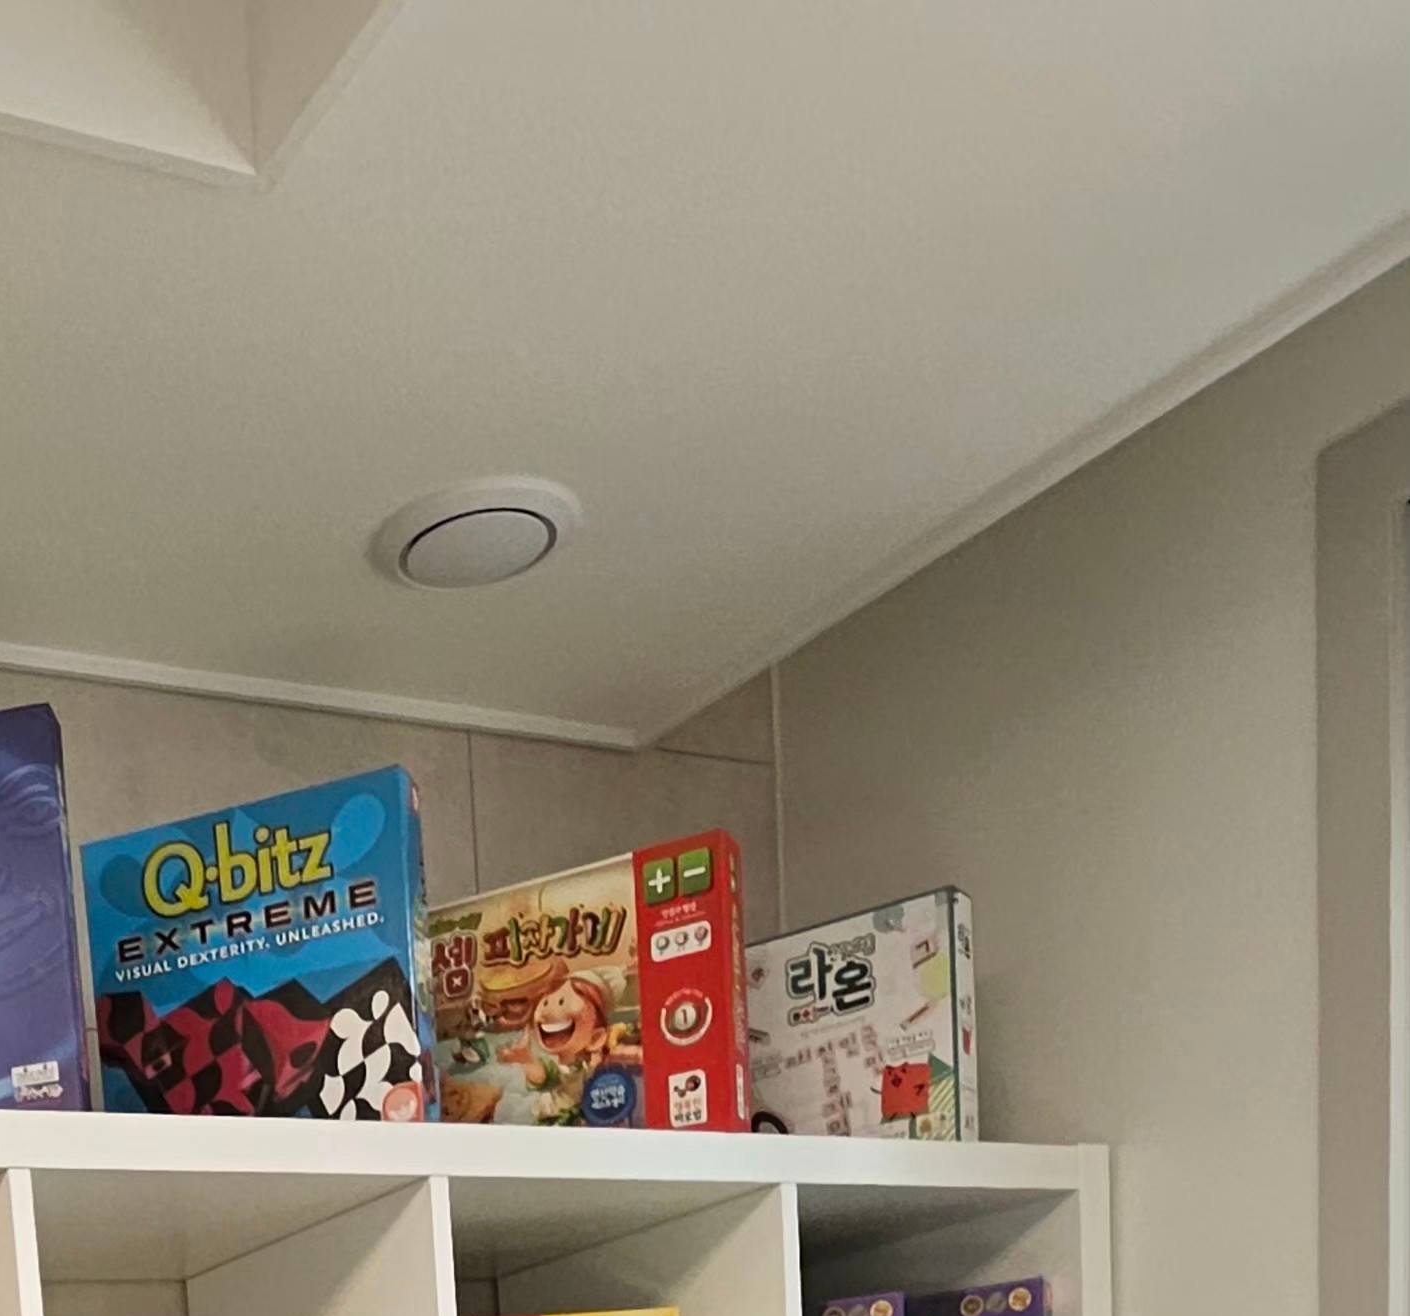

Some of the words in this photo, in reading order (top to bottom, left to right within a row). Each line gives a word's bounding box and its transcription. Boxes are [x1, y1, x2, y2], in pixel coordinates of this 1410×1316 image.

[116, 959, 172, 984] VISUAL
[177, 937, 271, 970] DEXTERITY.
[275, 911, 385, 947] UNLEASHED.
[117, 881, 378, 964] EXTREME
